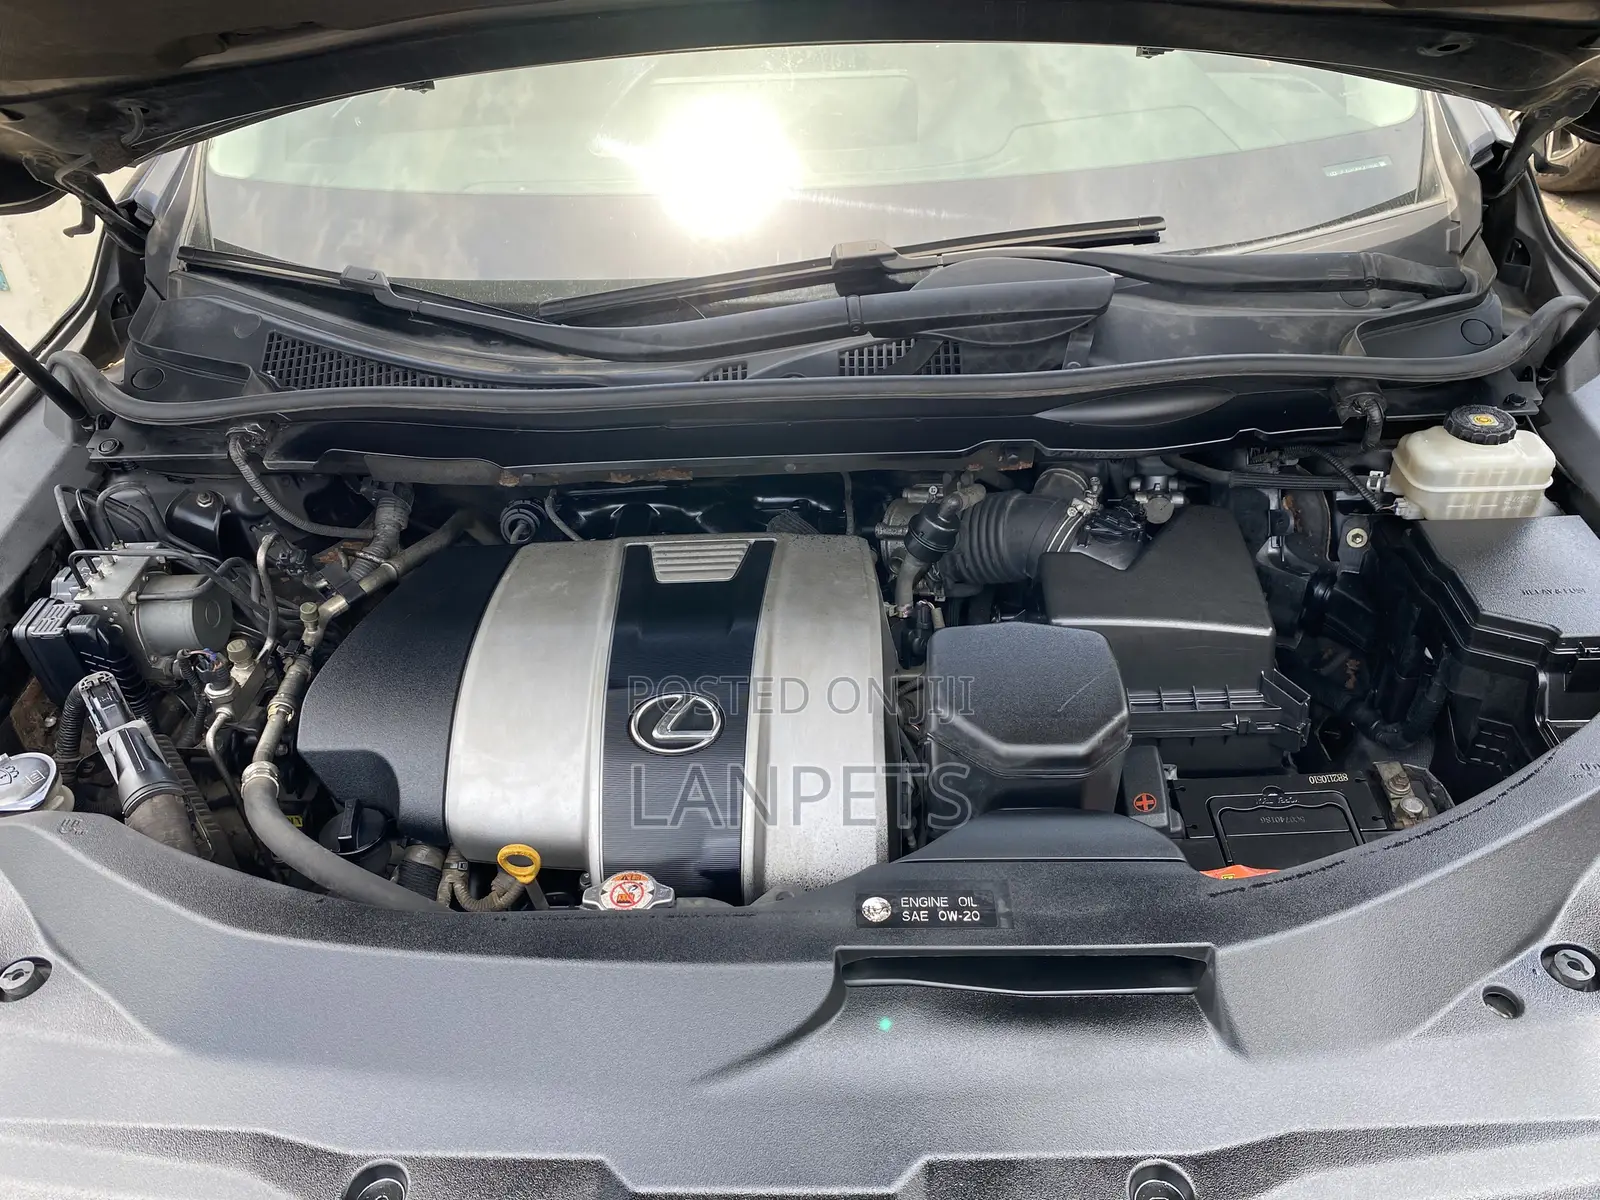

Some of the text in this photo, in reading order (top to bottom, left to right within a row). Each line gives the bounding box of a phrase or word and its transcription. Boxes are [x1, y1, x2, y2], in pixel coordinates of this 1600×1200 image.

[900, 896, 978, 908] ENGINE OIL
[901, 910, 930, 922] SAE
[938, 910, 981, 922] 0W-20
